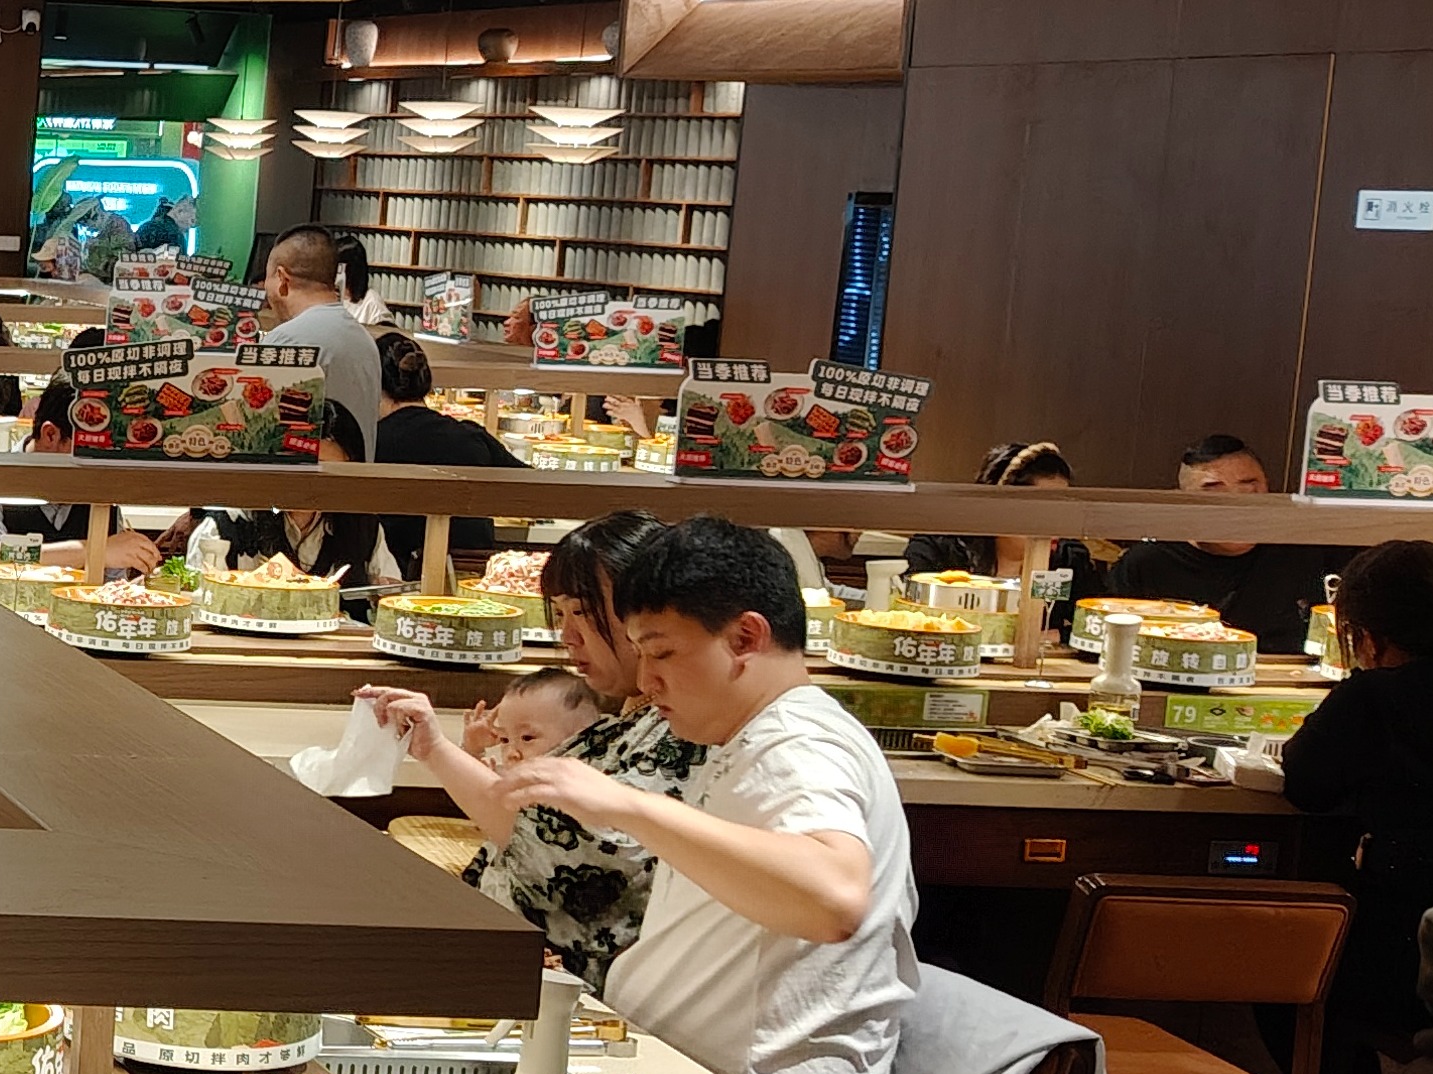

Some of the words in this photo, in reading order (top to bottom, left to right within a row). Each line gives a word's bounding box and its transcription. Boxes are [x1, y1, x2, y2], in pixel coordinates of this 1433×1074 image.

[69, 340, 188, 368] 100%原切非调理
[241, 347, 316, 366] 当季推荐
[76, 360, 184, 385] 每日现拌不隔夜
[696, 362, 769, 382] 当季推荐
[818, 365, 930, 397] 100%原切非调理
[1327, 385, 1399, 403] 当季推荐
[94, 609, 157, 639] 佑年年
[396, 616, 455, 647] 佑年年
[893, 636, 957, 665] 佑年年
[1173, 706, 1197, 723] 79
